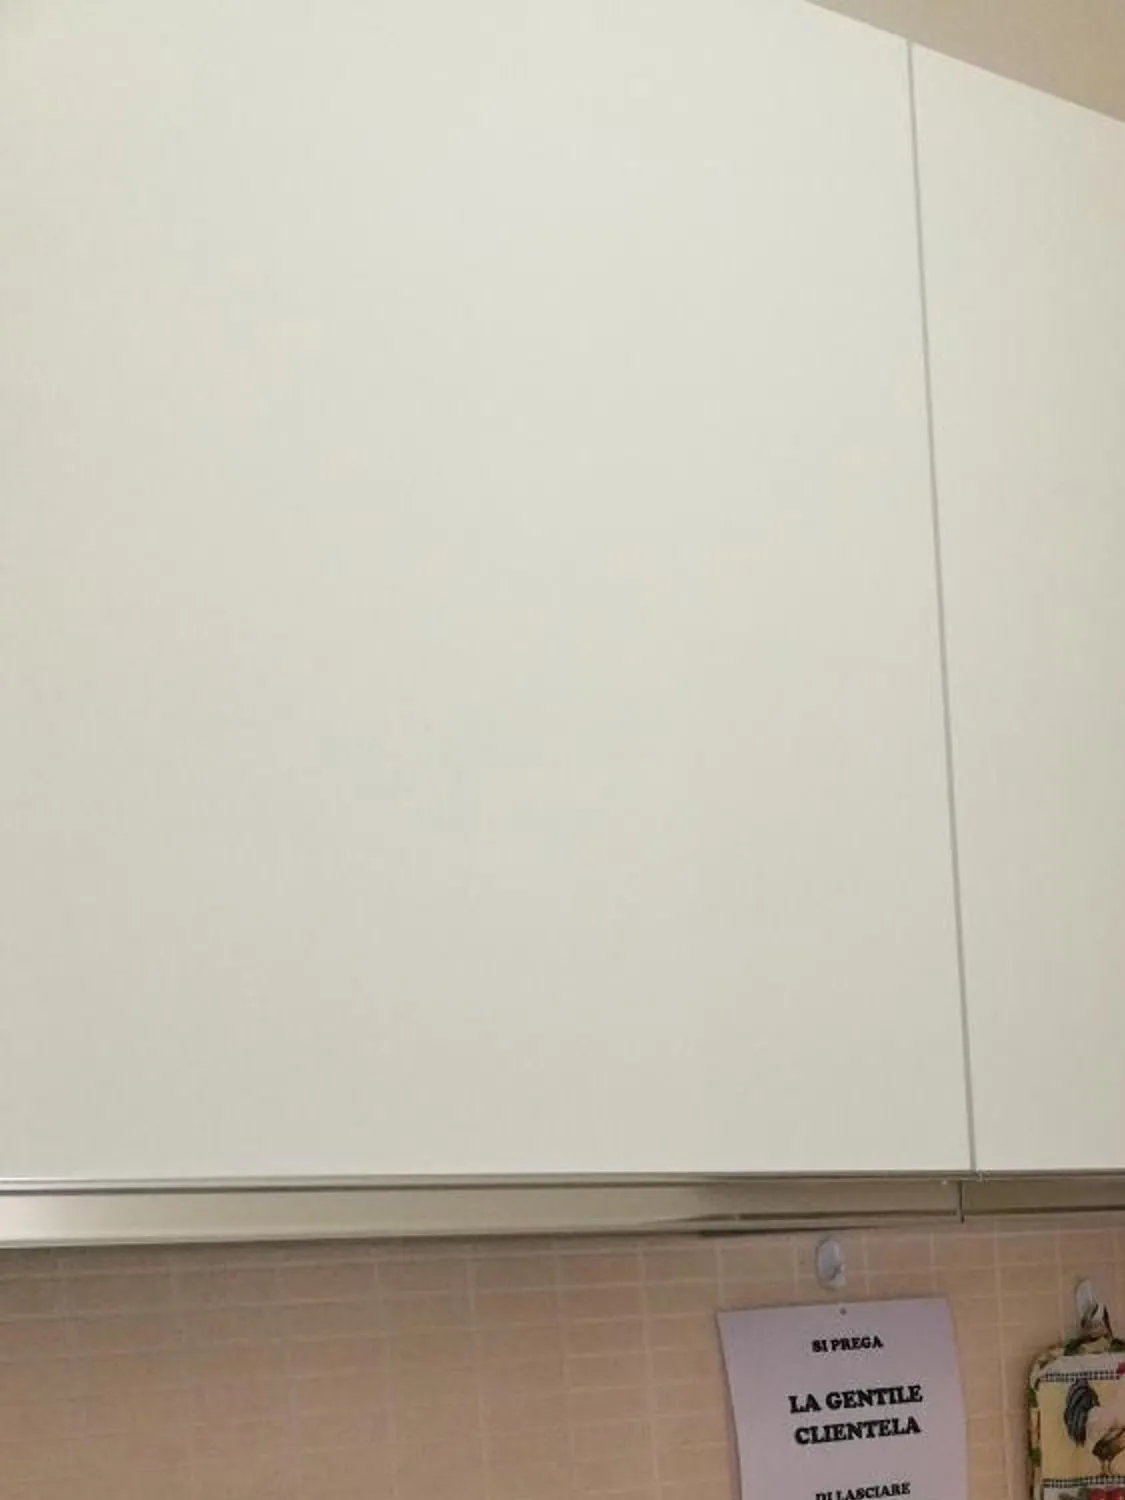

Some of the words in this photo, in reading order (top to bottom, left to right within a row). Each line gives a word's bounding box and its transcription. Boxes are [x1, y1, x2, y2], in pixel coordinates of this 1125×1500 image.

[811, 1339, 828, 1353] SI
[830, 1336, 884, 1351] PREGA
[788, 1394, 821, 1413] LA
[825, 1385, 923, 1410] GENTILE
[794, 1417, 921, 1445] CLIENTELA
